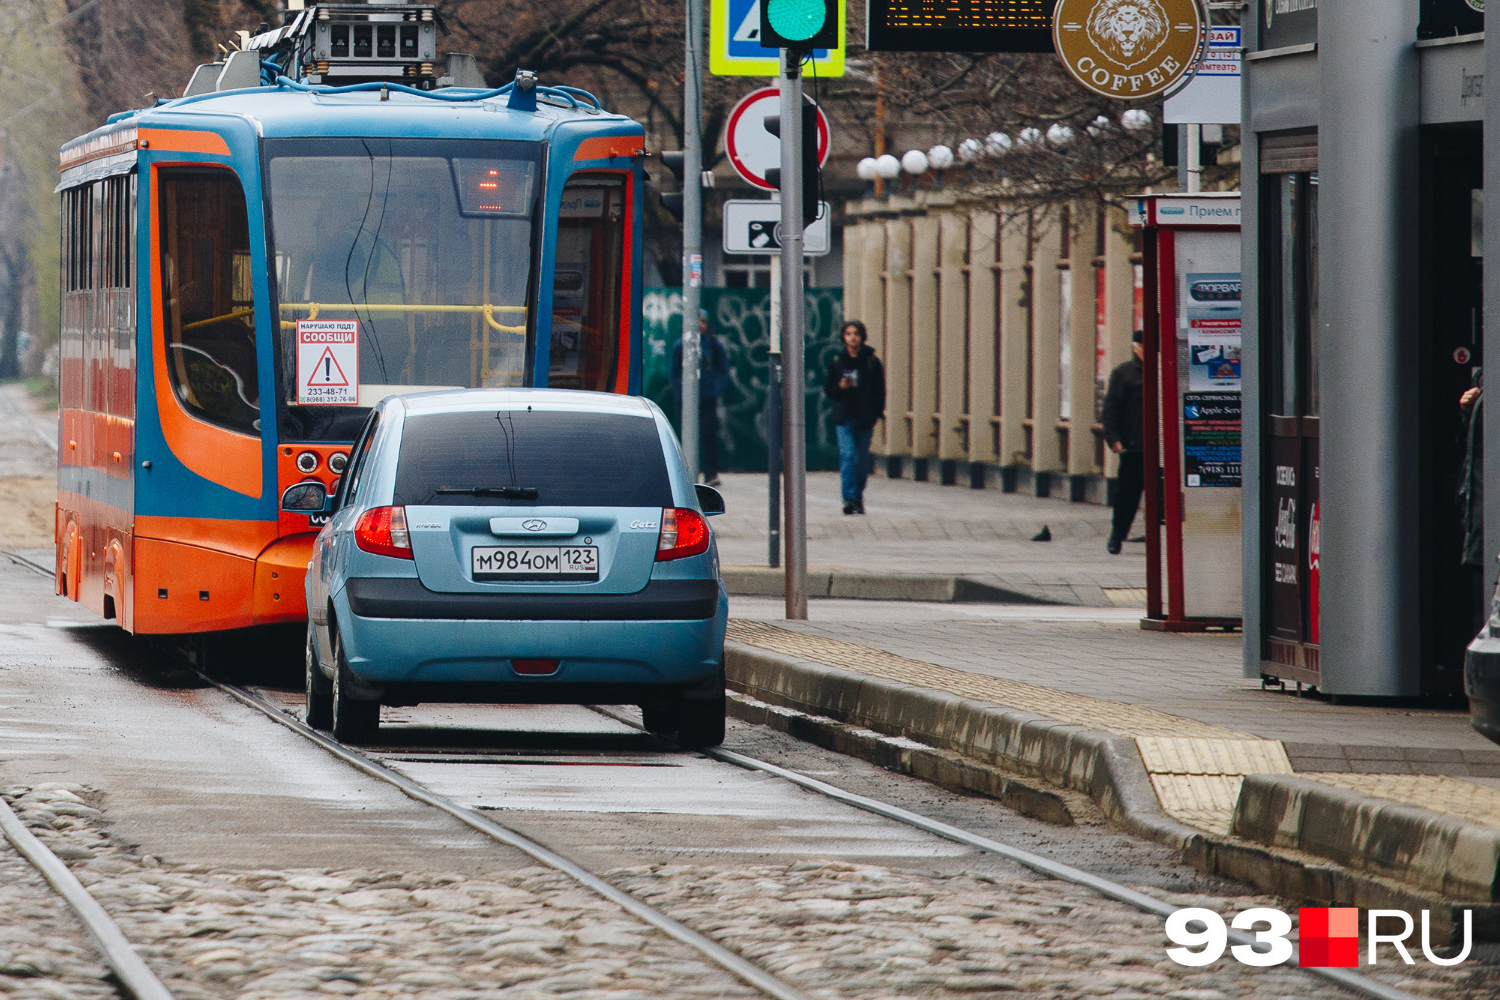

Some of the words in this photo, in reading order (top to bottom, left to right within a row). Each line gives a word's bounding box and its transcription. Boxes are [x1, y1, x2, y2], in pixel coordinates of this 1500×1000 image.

[1077, 55, 1181, 92] COFFEE
[1189, 205, 1232, 218] Прием
[303, 332, 353, 343] СООБЩИ
[308, 388, 348, 396] 233-48-71
[1200, 407, 1223, 415] Apple
[629, 519, 657, 530] Getz
[562, 549, 592, 565] 123
